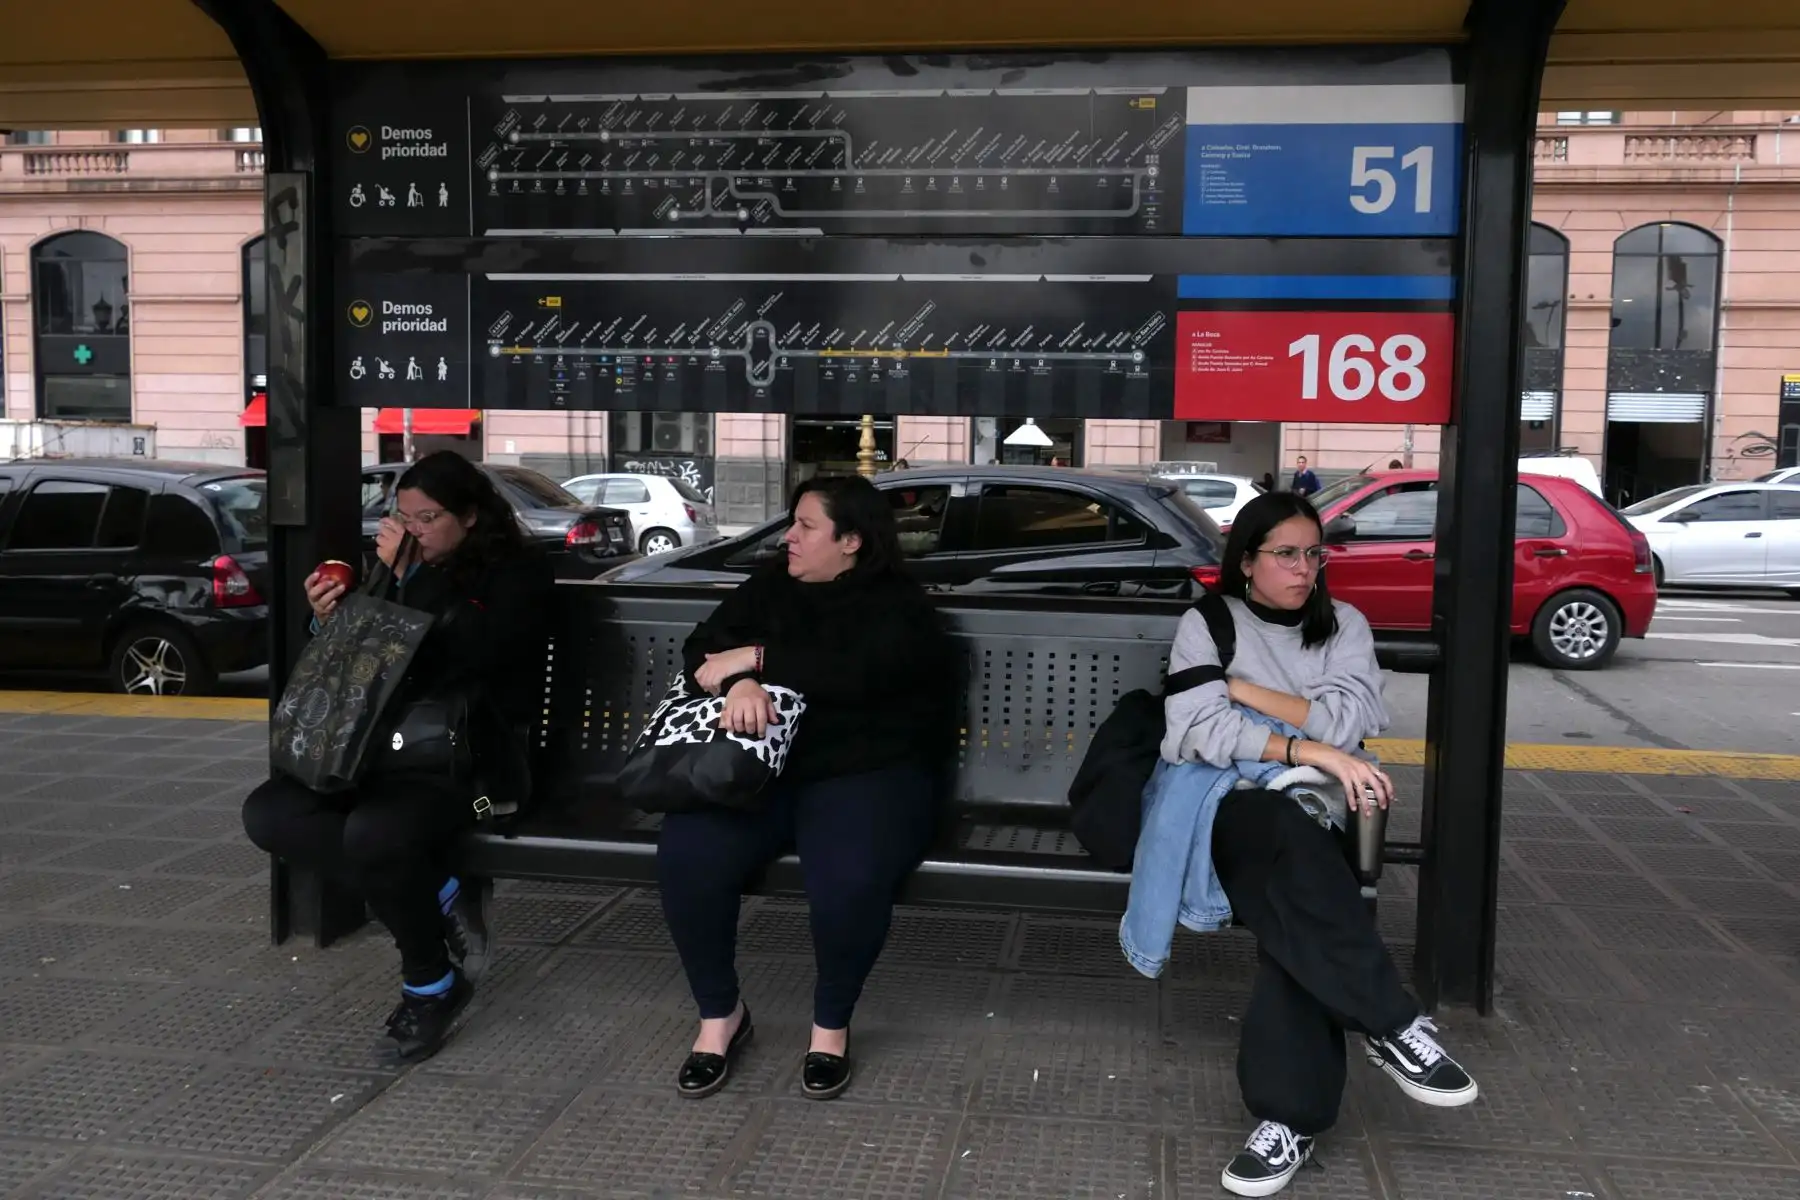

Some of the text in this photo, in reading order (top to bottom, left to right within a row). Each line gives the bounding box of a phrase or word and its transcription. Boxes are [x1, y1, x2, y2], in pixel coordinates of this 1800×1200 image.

[381, 126, 432, 140] Demos
[382, 143, 447, 160] prioridad
[1350, 146, 1433, 214] 51
[382, 301, 432, 315] Demos
[382, 318, 447, 334] prioridad
[1288, 334, 1426, 401] 168
